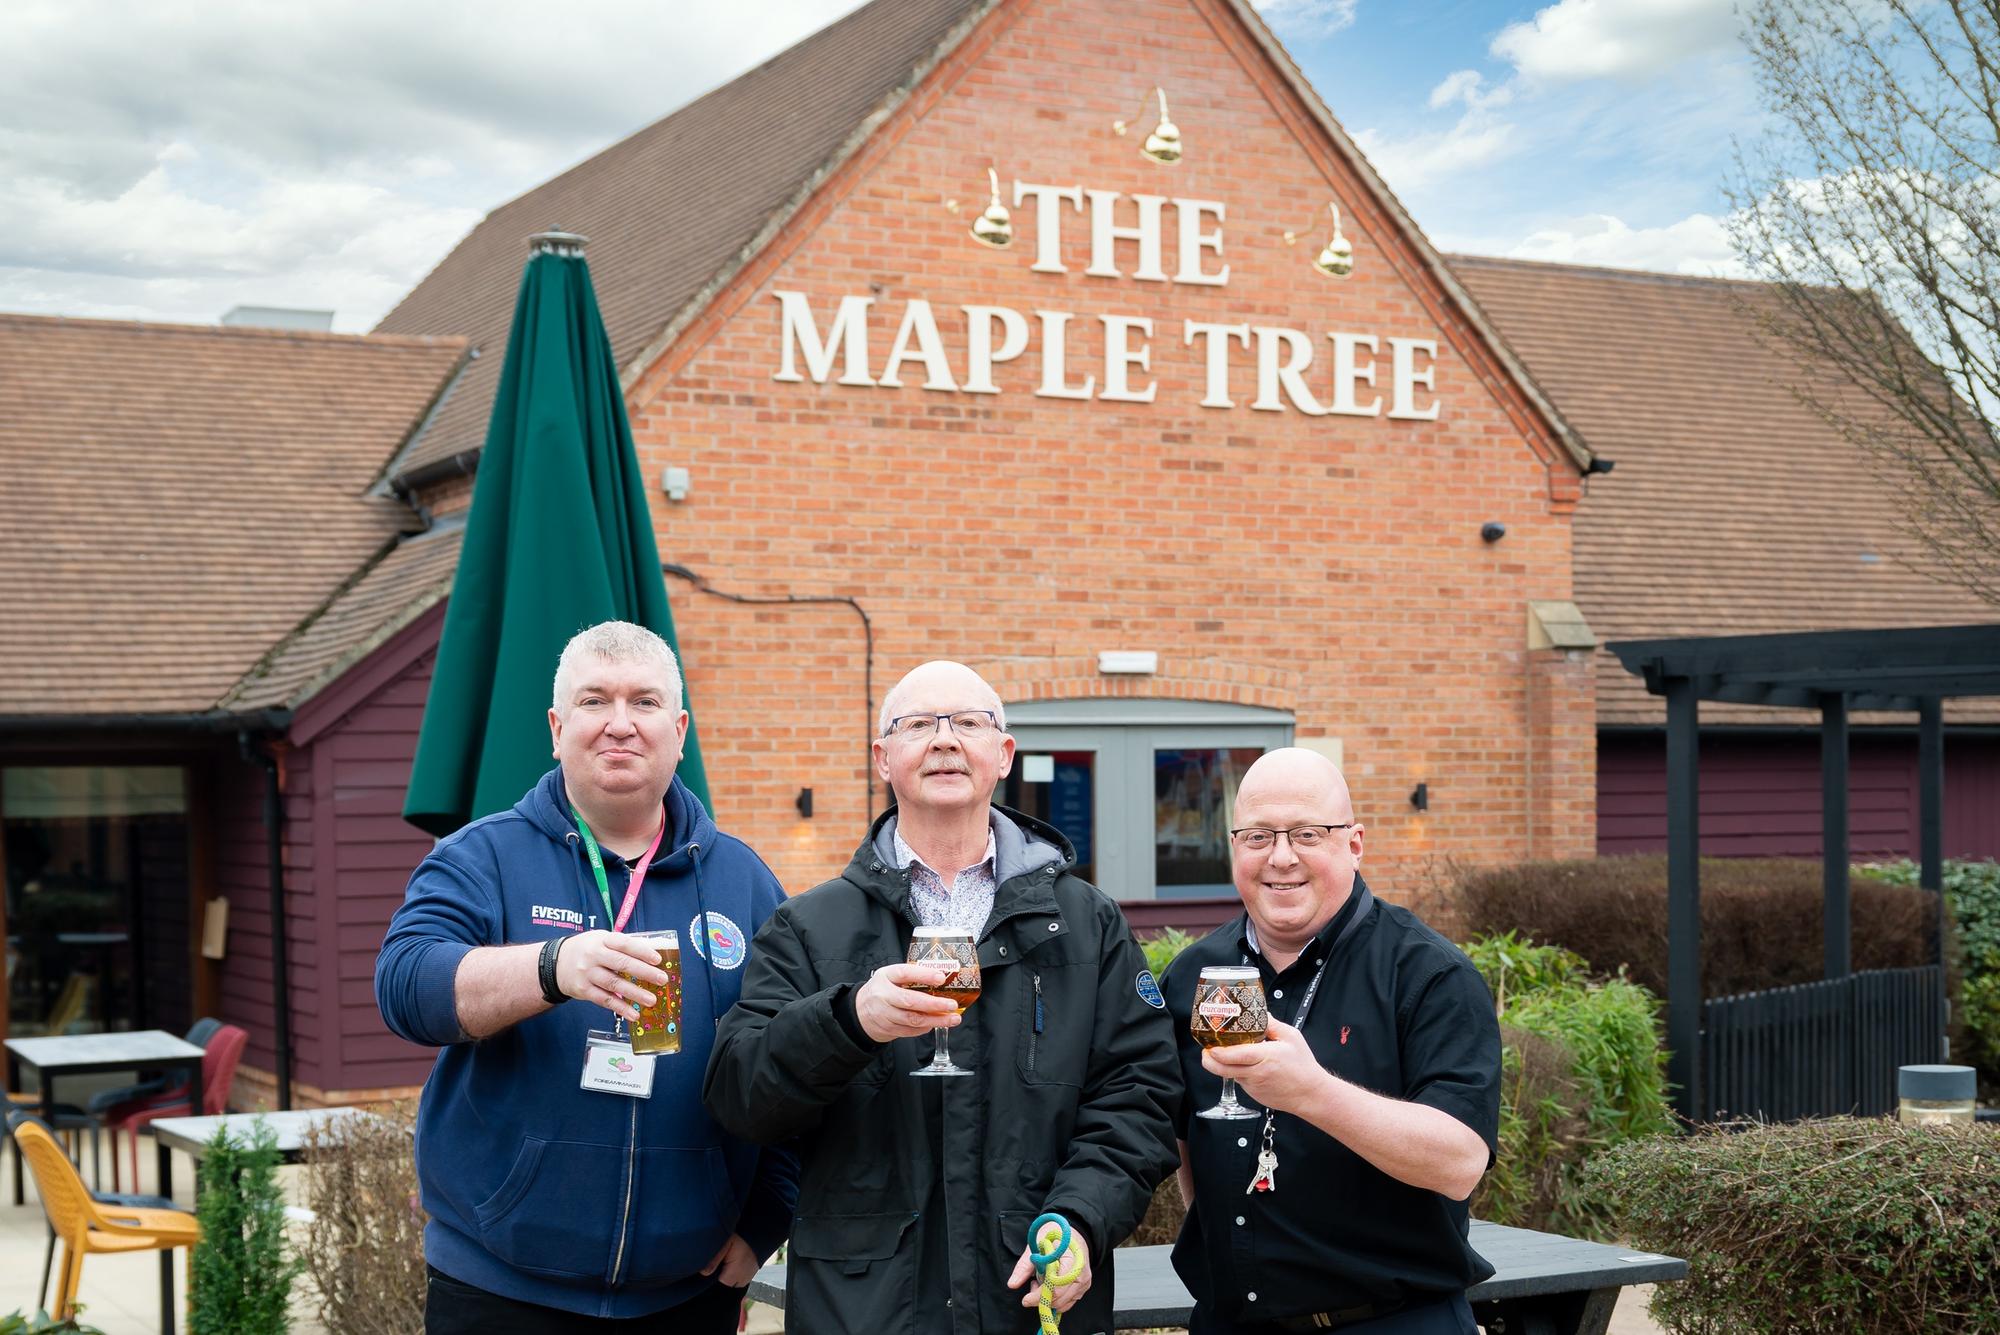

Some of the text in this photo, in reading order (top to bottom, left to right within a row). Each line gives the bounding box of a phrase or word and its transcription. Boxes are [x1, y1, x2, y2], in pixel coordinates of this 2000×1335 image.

[1012, 179, 1231, 287] THE
[772, 289, 1442, 422] MAPLE TREE
[531, 905, 597, 928] EVESTRUT
[1200, 1005, 1238, 1014] Cruzcampo
[1302, 992, 1313, 1008] Tree
